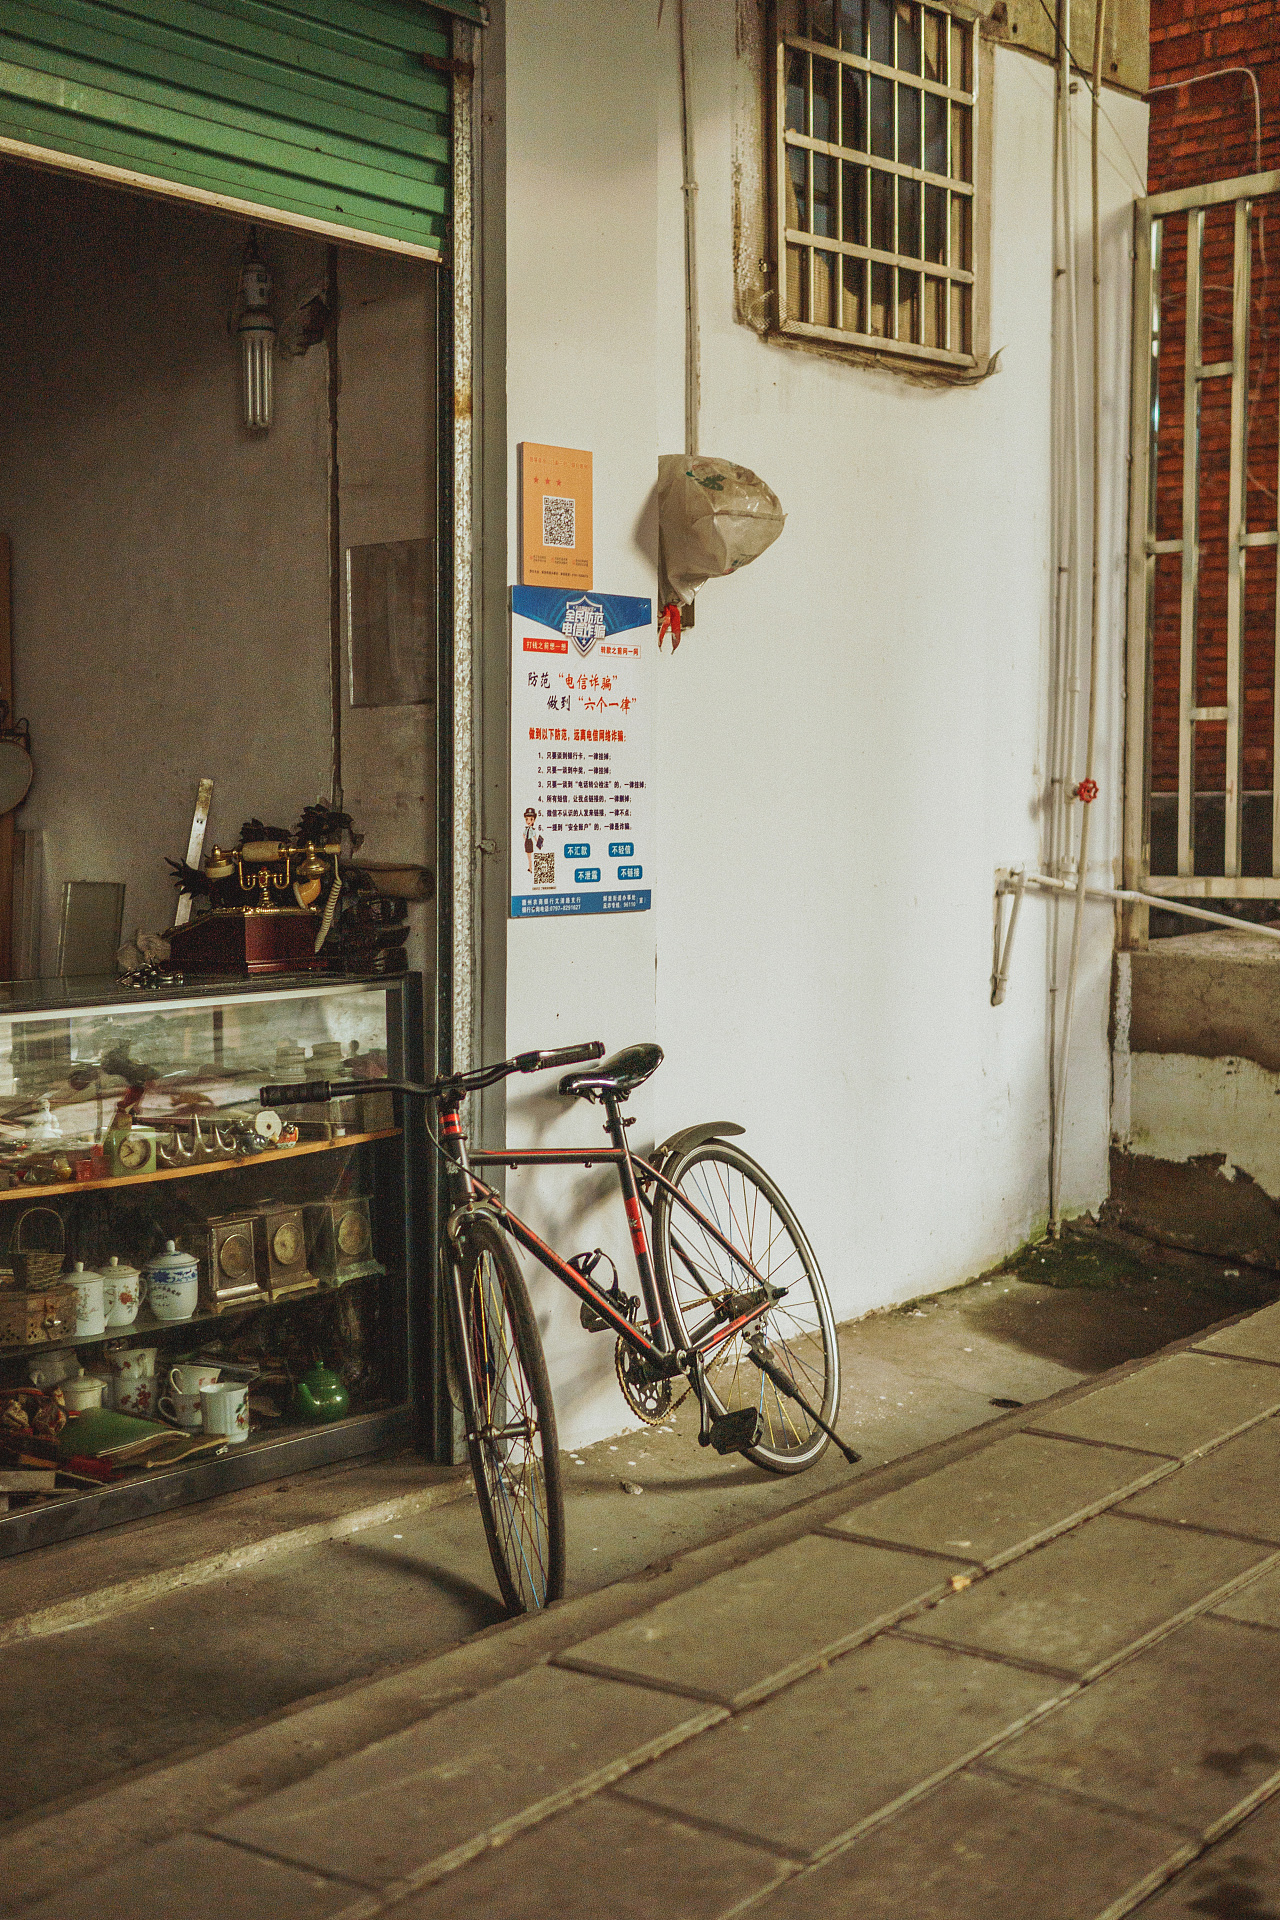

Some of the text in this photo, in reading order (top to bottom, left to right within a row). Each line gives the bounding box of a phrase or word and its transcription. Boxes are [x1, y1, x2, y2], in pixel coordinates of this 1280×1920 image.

[564, 609, 605, 624] 全民防范
[562, 622, 606, 638] 电信诈骗
[567, 846, 588, 856] 不汇款
[612, 845, 631, 855] 不轻信
[578, 870, 598, 880] 不泄露
[620, 868, 640, 878] 不链接
